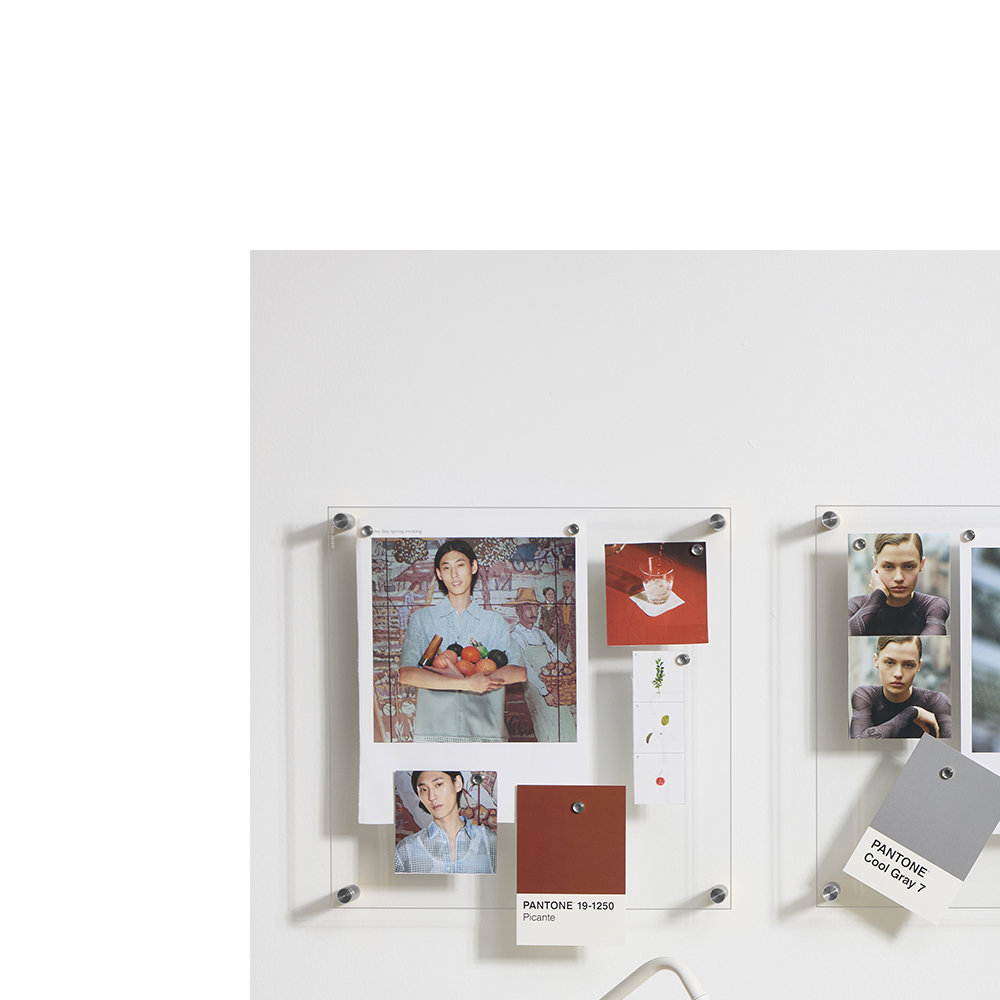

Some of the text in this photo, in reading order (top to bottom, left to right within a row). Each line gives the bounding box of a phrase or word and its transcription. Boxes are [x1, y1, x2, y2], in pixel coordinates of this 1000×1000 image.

[870, 838, 929, 879] PANTONE
[863, 852, 927, 893] Cool Gray 7
[522, 912, 556, 922] Picante
[523, 900, 615, 911] PANTONE 19-1250
